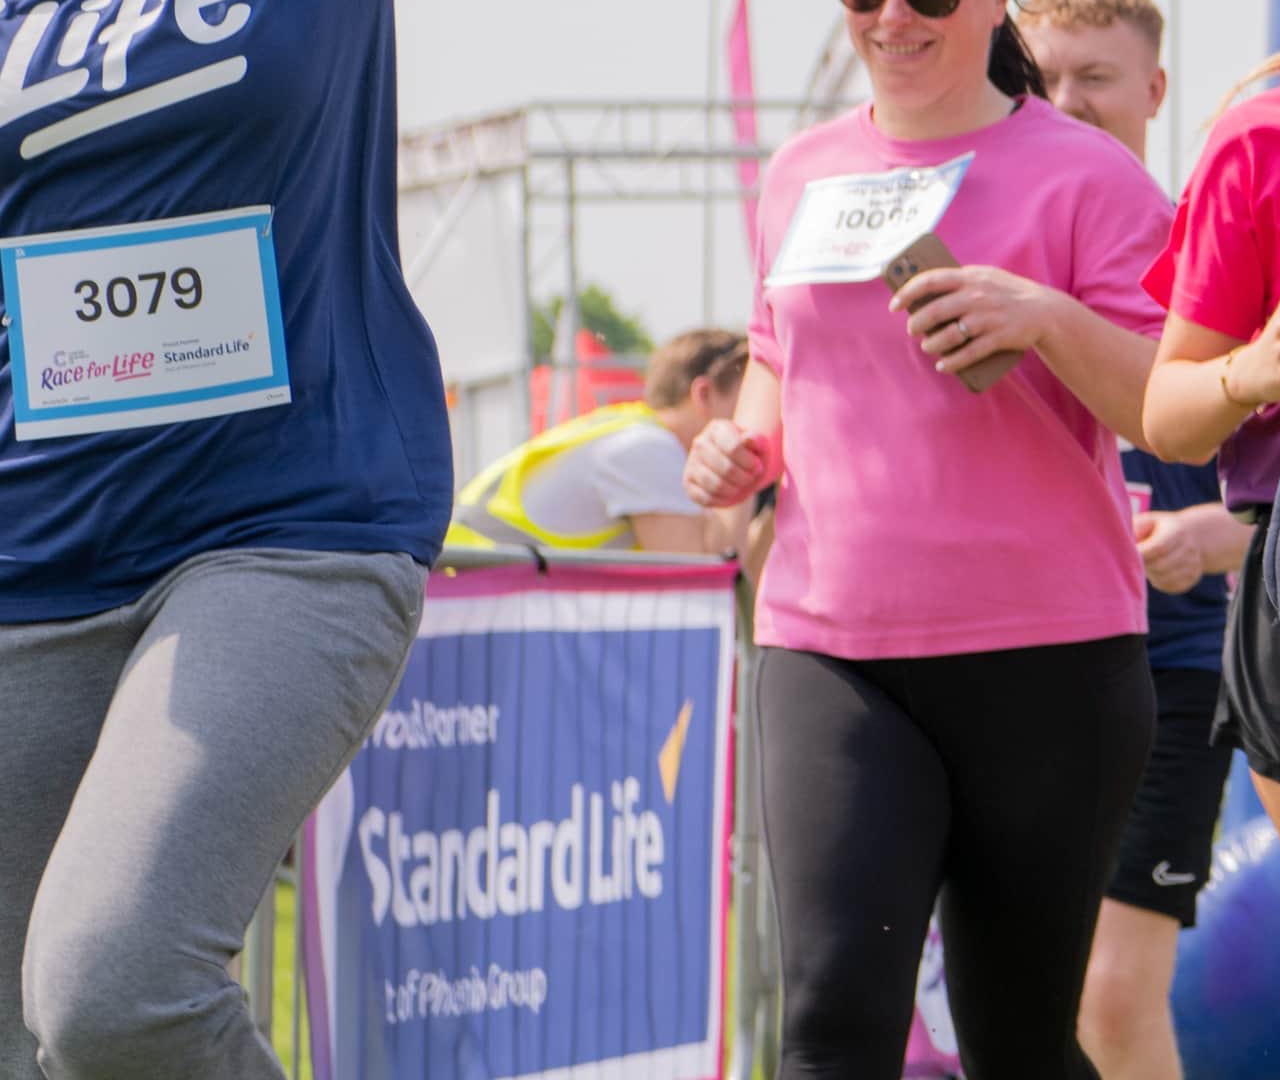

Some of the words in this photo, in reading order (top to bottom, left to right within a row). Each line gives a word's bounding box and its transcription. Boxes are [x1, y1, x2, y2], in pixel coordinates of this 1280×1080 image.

[74, 267, 203, 322] 3079
[41, 363, 83, 390] Race
[87, 361, 111, 380] for
[111, 351, 155, 377] Life
[164, 345, 223, 365] Standard
[225, 338, 250, 355] Life
[362, 698, 428, 750] roud
[358, 781, 584, 927] Standard
[588, 776, 665, 905] Life
[488, 962, 547, 1015] Group
